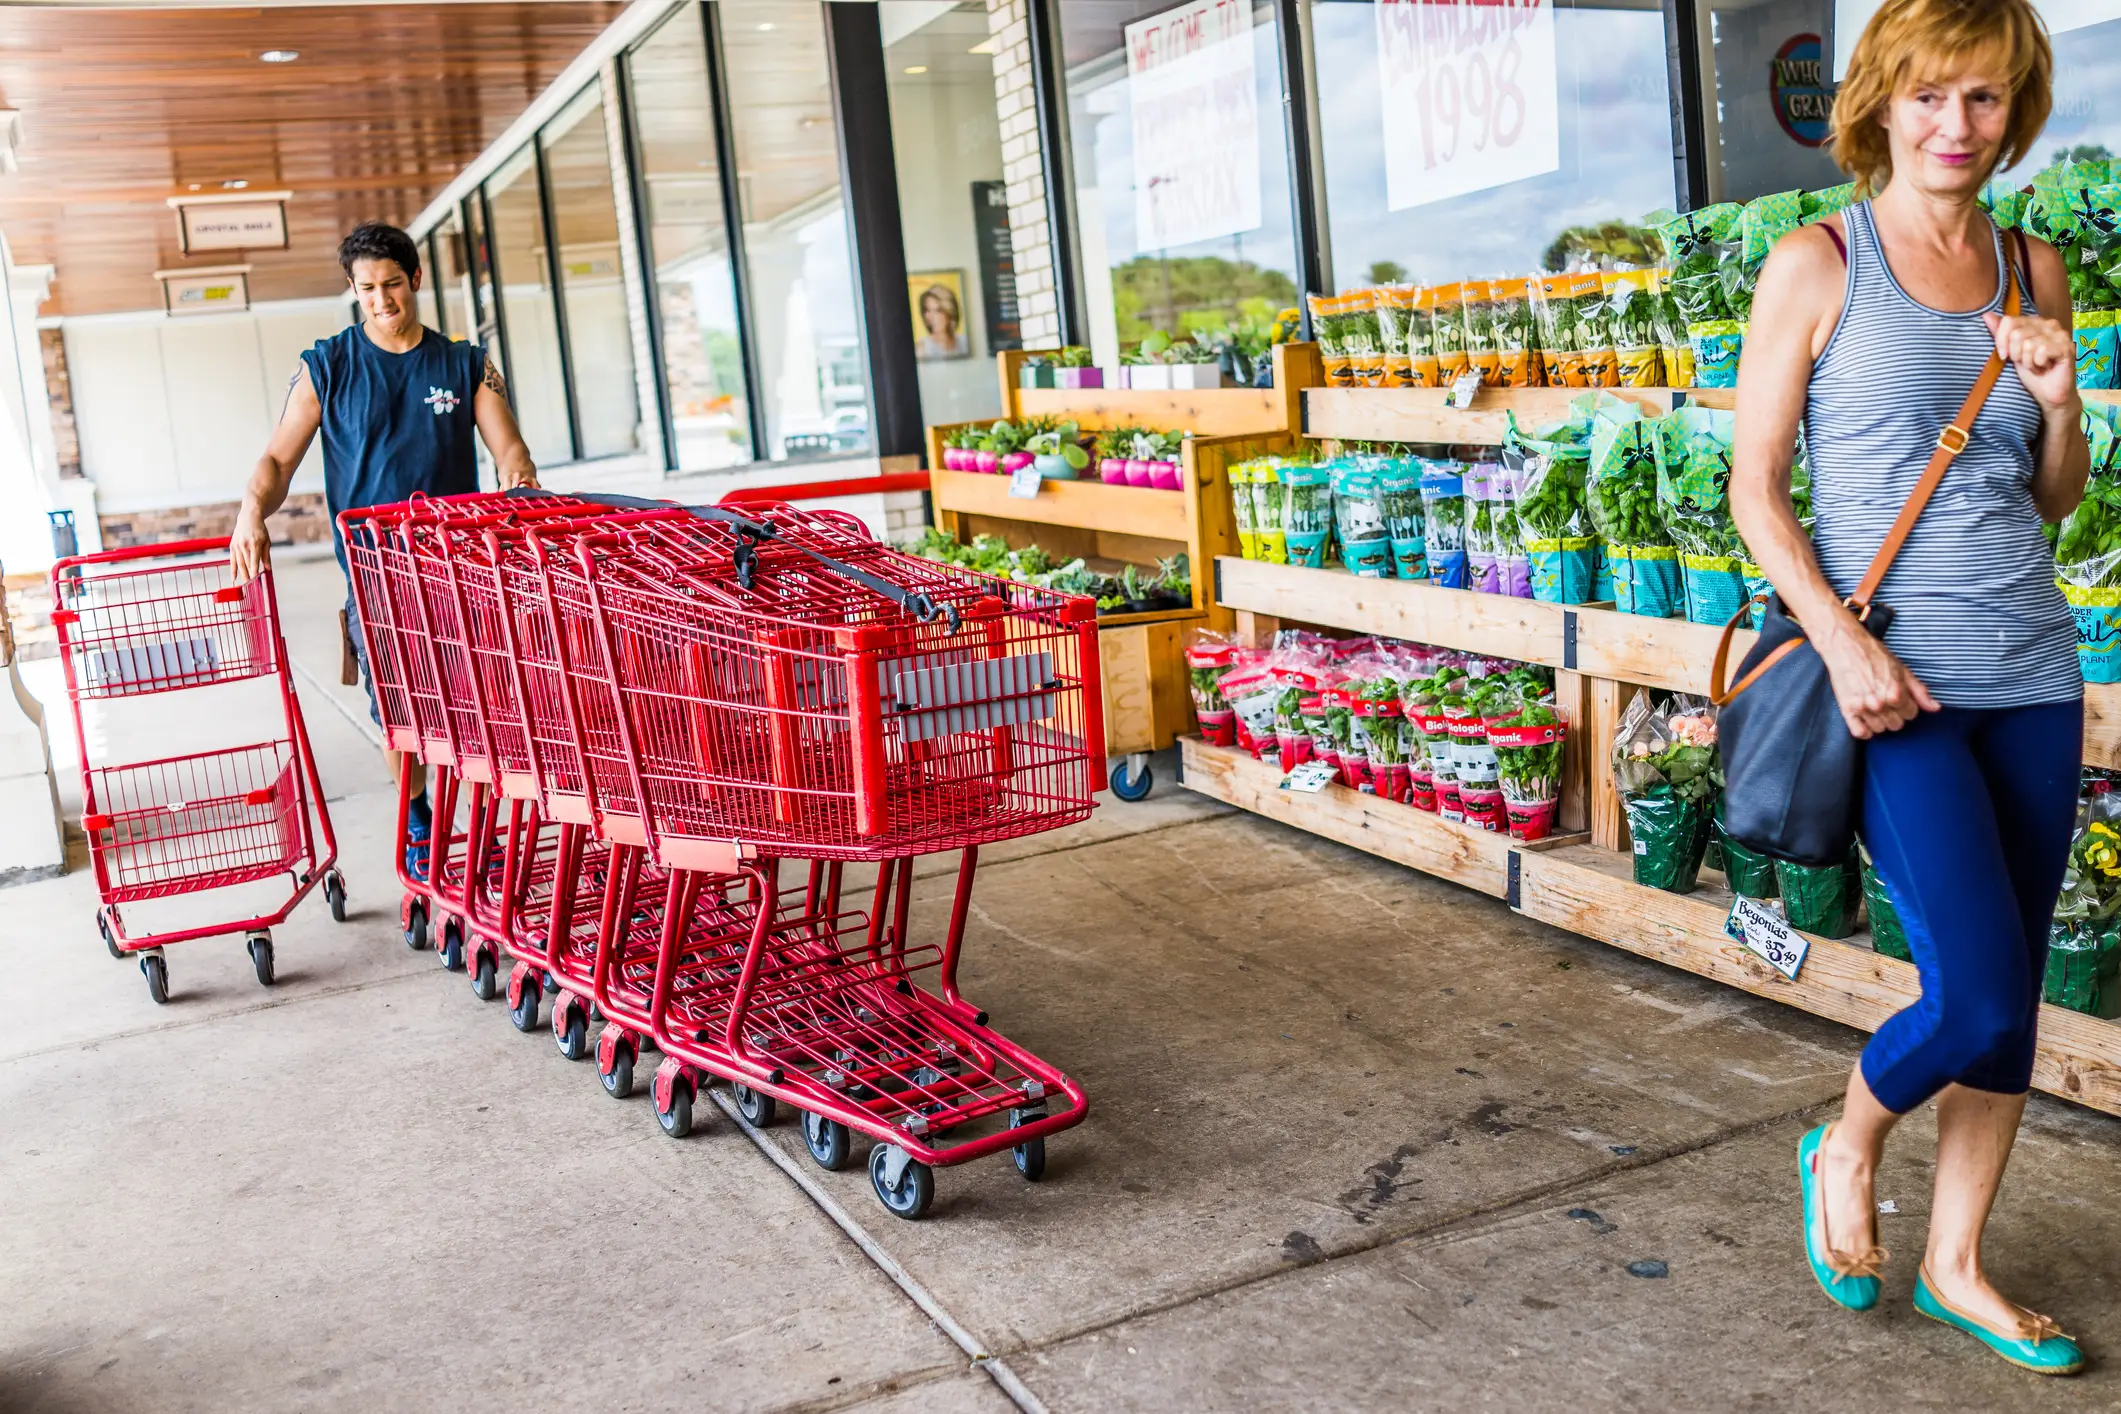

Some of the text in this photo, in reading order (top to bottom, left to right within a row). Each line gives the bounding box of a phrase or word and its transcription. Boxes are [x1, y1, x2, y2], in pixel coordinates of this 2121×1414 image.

[1132, 9, 1207, 72] WELCOME
[1781, 60, 1821, 84] WHO
[1415, 36, 1526, 171] 1998
[2070, 608, 2092, 616] ADER
[2077, 620, 2113, 643] sil
[2080, 655, 2111, 664] PLANT
[1738, 900, 1788, 940] Begonias
